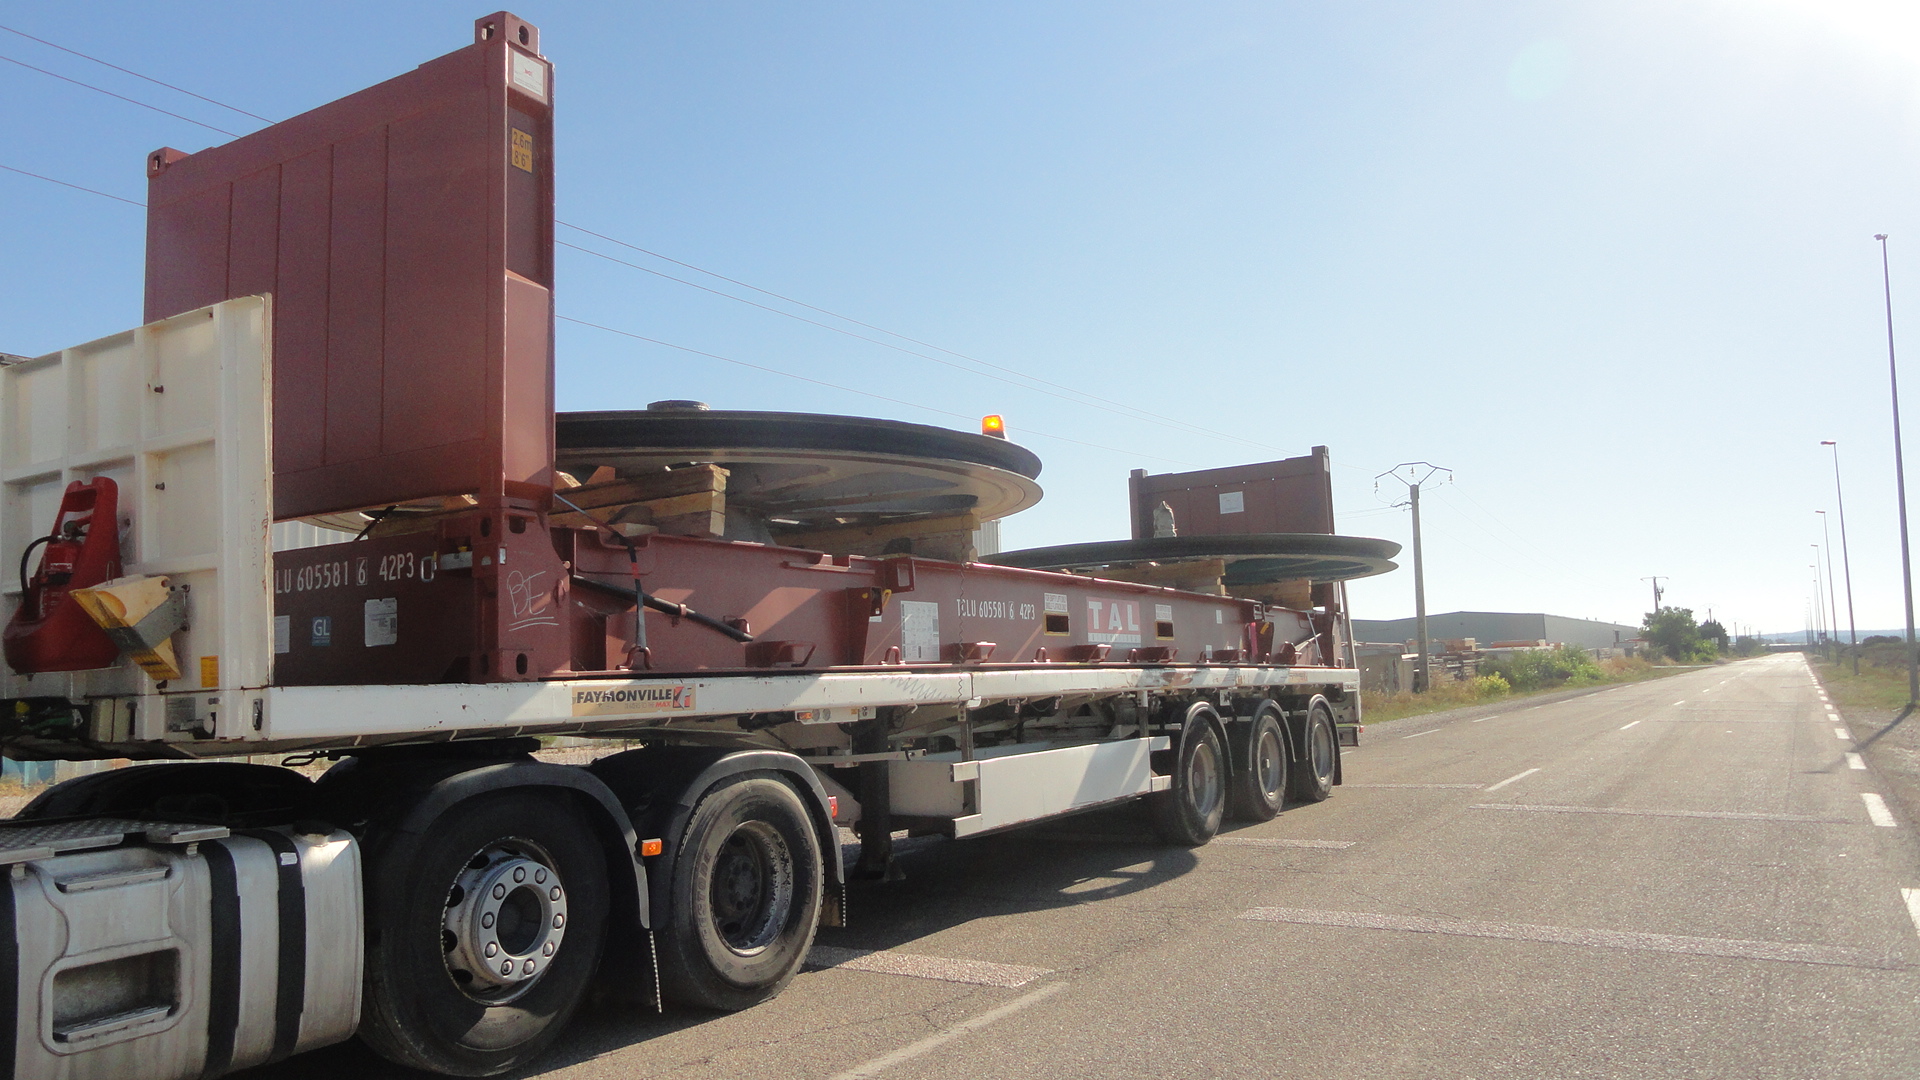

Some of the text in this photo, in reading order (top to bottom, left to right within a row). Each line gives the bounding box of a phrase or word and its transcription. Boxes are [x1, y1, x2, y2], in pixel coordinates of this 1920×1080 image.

[297, 561, 349, 592] 605581
[358, 559, 367, 584] 6
[379, 552, 414, 581] 42P3
[979, 601, 1006, 618] 605581
[1019, 603, 1036, 620] 42P3
[1088, 601, 1139, 631] TAL
[313, 619, 330, 636] GL
[576, 689, 672, 704] FAYMONVILLE
